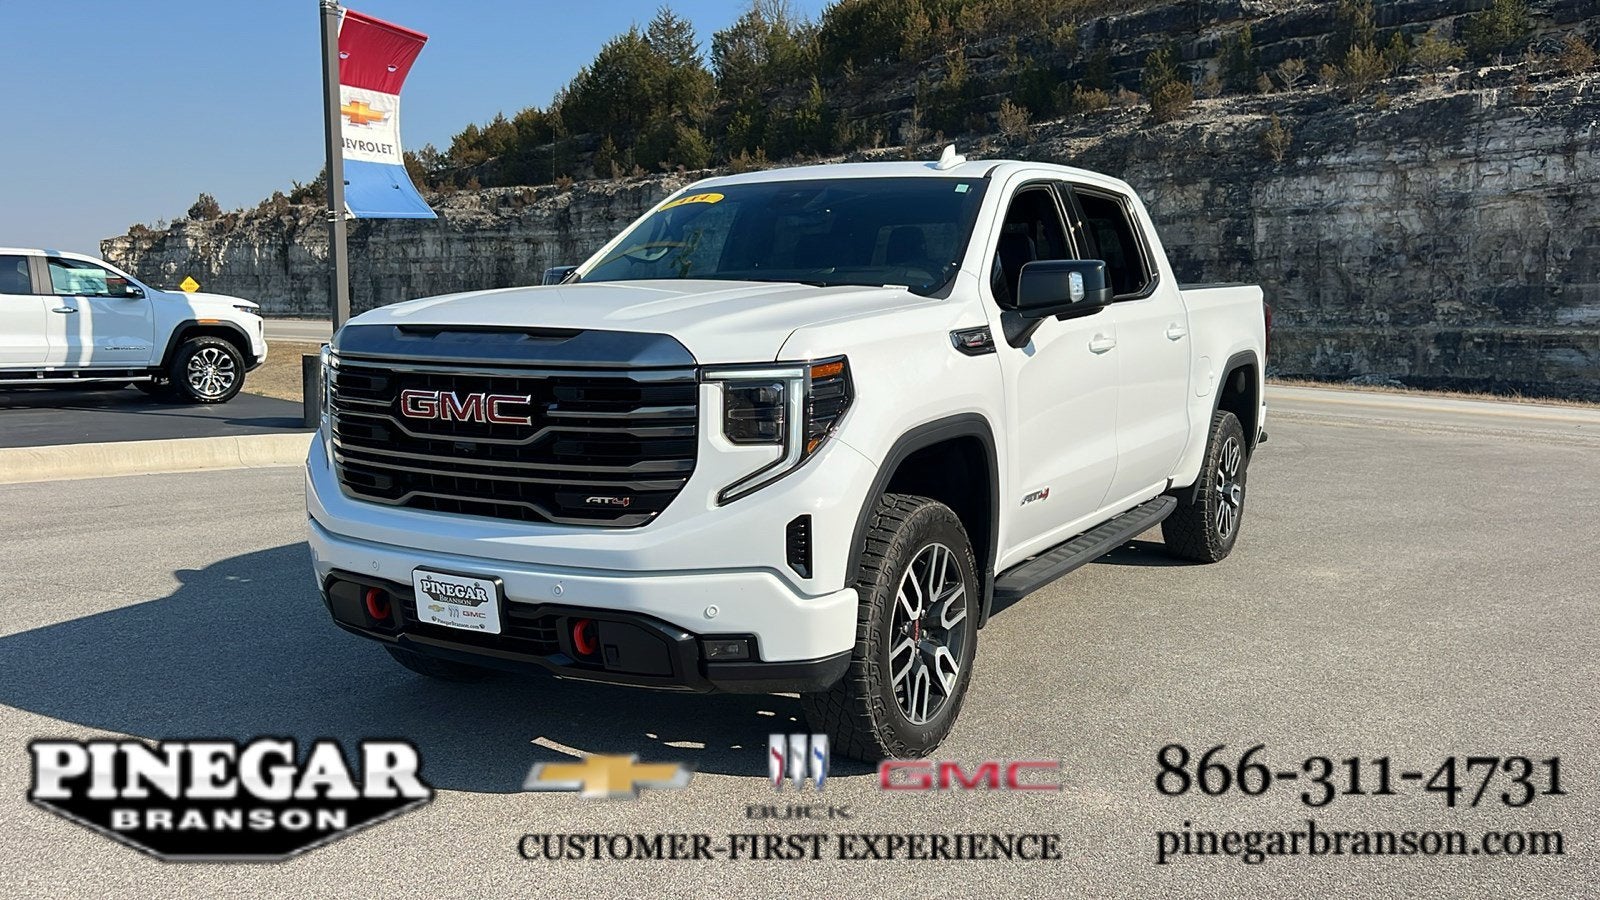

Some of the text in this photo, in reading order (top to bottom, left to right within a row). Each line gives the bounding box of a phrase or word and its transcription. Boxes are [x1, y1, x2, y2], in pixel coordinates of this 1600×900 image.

[341, 137, 394, 155] EVROLET
[401, 389, 532, 426] GMC
[586, 496, 630, 507] AT4
[421, 580, 488, 602] PINEGAR
[462, 610, 486, 619] GMC
